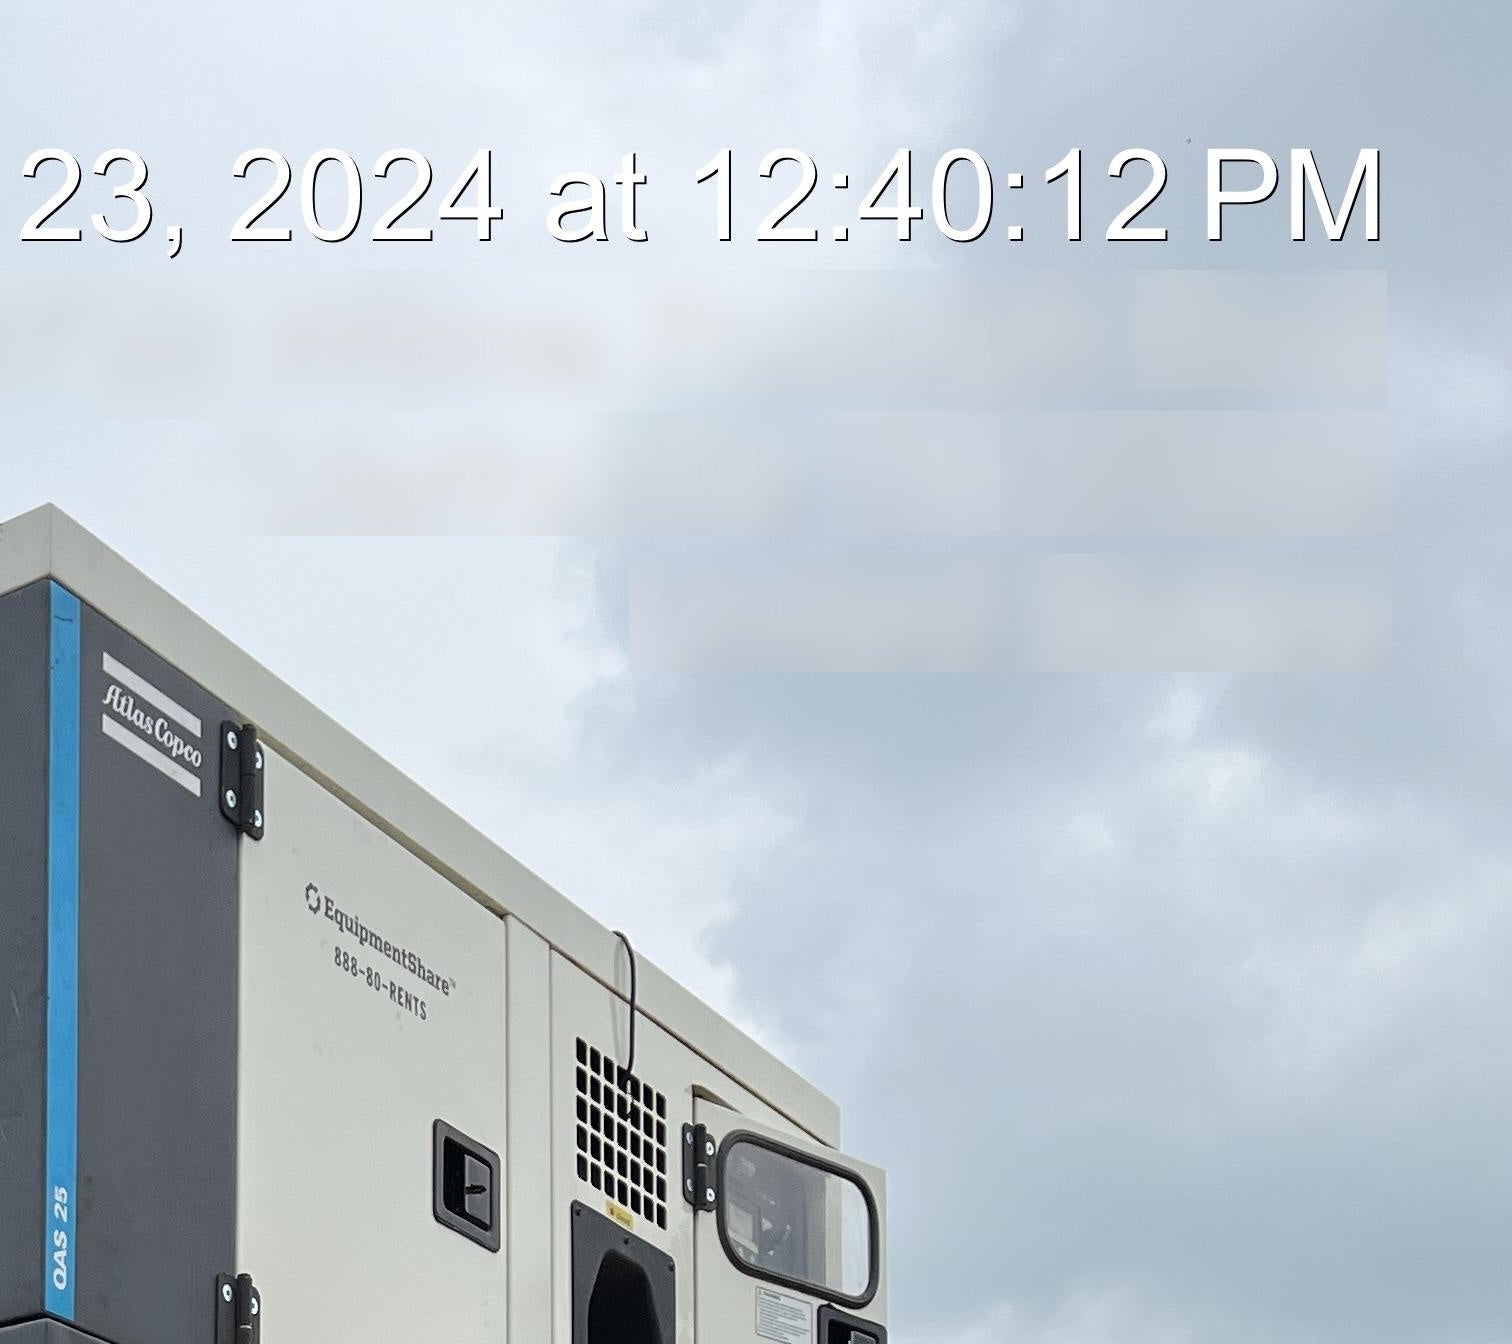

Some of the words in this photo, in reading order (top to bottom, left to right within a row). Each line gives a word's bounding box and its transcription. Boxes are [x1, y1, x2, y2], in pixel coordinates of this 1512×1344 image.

[102, 685, 154, 735] Atlas
[154, 718, 202, 768] Copco
[334, 946, 427, 1021] 888-80-RENTS
[54, 1185, 68, 1223] 25
